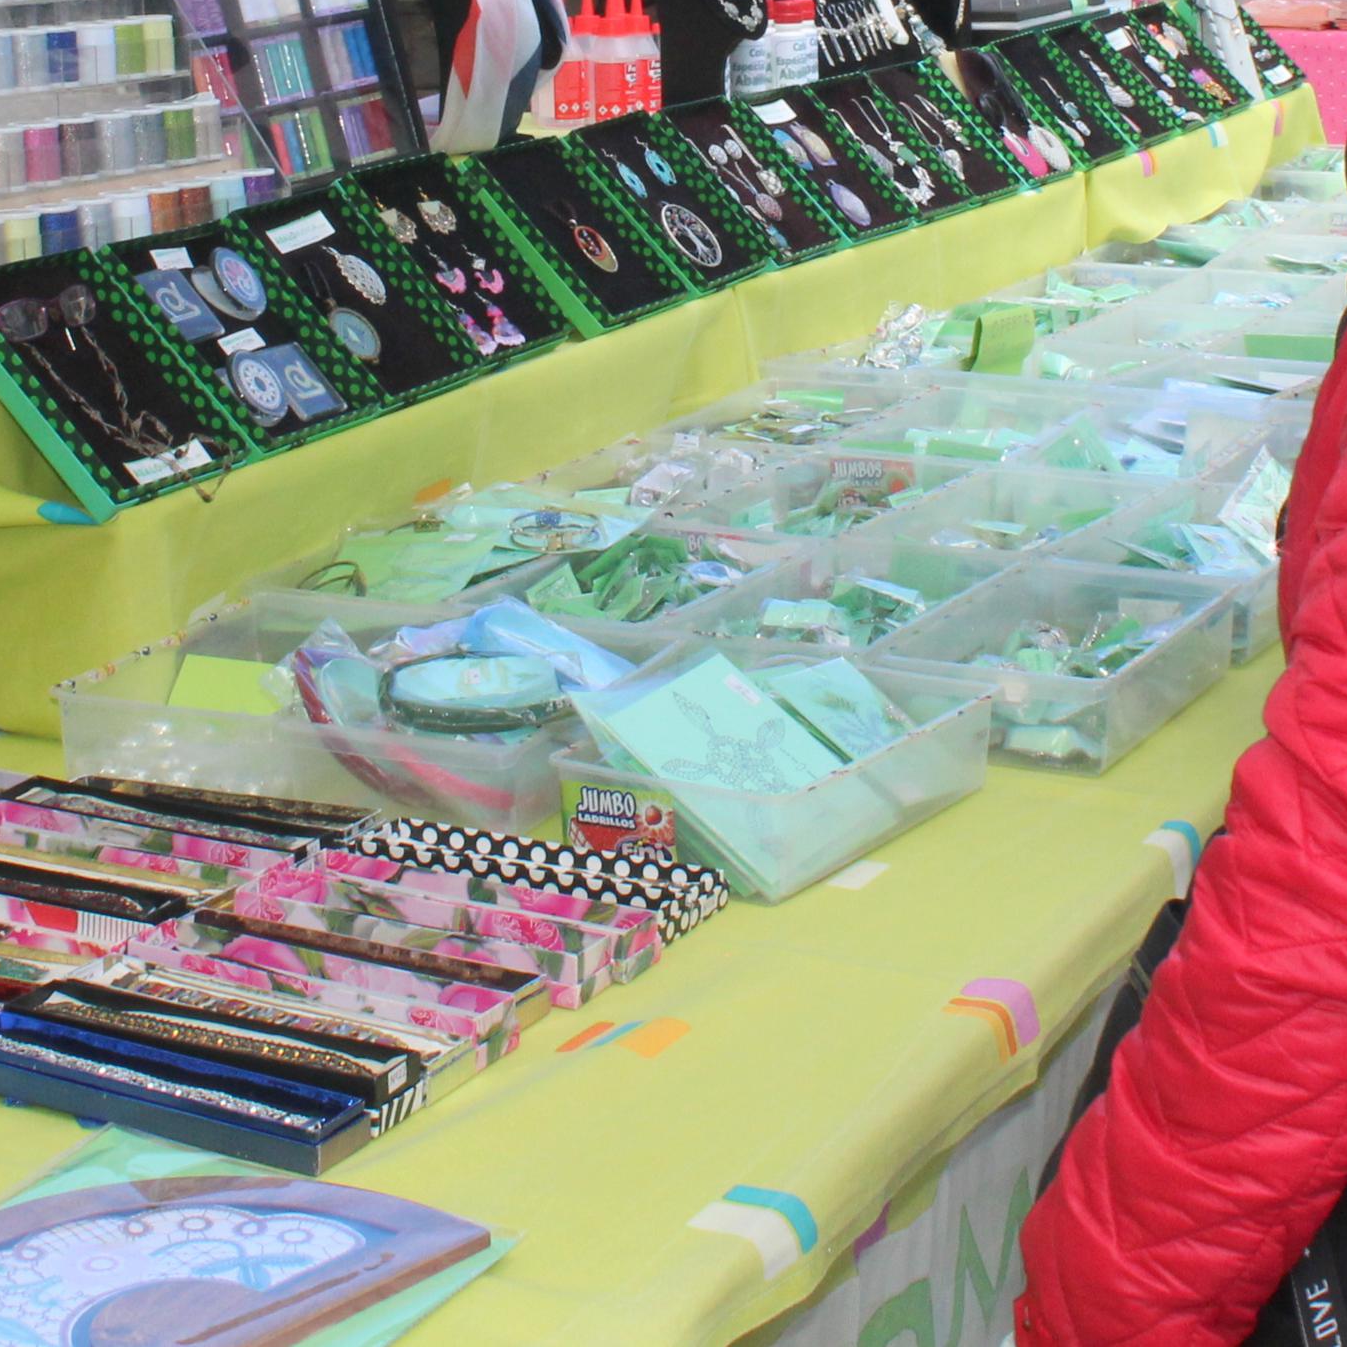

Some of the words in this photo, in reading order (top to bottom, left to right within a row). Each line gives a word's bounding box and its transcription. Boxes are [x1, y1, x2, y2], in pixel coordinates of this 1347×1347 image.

[832, 459, 883, 478] JUMBOS
[577, 786, 636, 817] JUMBO
[578, 812, 636, 829] LADRILLOS
[621, 840, 667, 862] Fini
